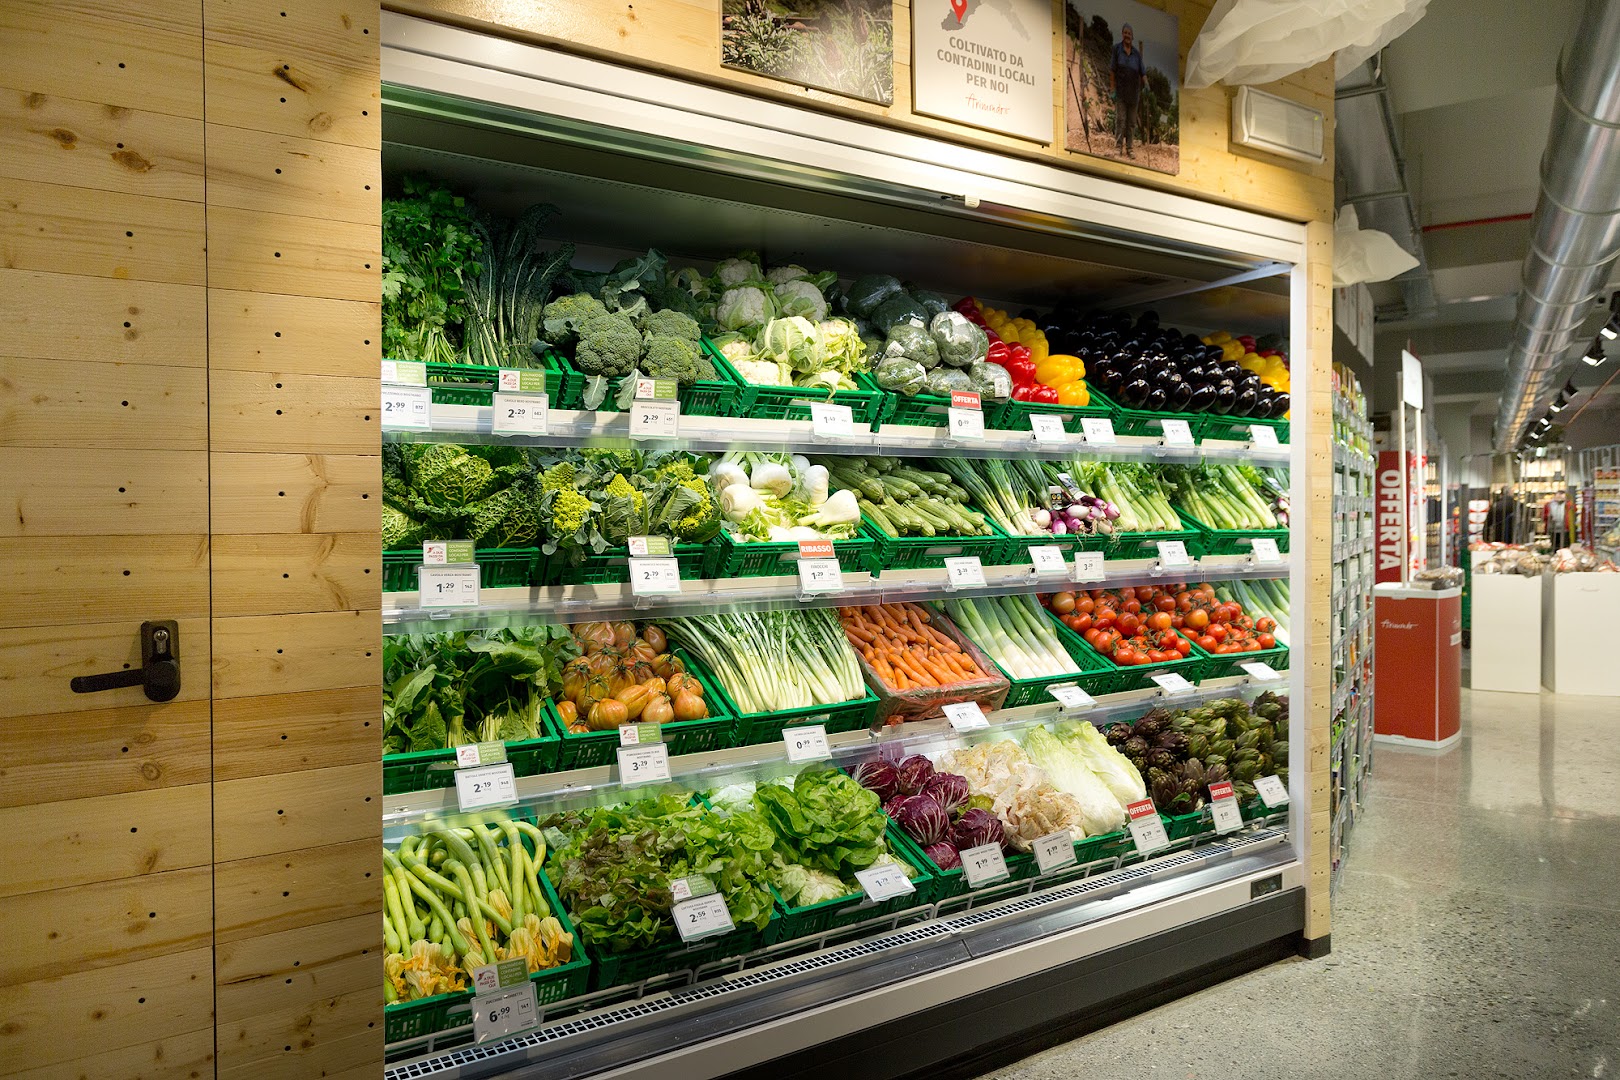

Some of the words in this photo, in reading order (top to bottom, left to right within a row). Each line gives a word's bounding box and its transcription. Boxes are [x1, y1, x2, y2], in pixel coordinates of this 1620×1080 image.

[949, 36, 1007, 63] COLTIVATO
[1009, 53, 1024, 68] DA
[936, 48, 996, 76] CONTADINI
[999, 66, 1035, 86] LOCALI
[966, 72, 987, 89] PER
[990, 79, 1009, 95] NOI
[953, 395, 979, 405] OFFERTA
[385, 402, 406, 412] 2.99
[508, 408, 526, 418] 2.29
[643, 414, 659, 424] 2.29
[1379, 469, 1402, 571] OFFERTA
[800, 544, 832, 554] RIBASSO
[811, 571, 824, 580] 1.29
[436, 582, 455, 593] 1.29
[632, 760, 648, 771] 3.29
[473, 781, 492, 793] 2.19
[1212, 785, 1233, 798] OFFERTA
[1130, 803, 1154, 816] OFFERTA
[689, 910, 706, 923] 2.59
[489, 1006, 511, 1023] 6.99
